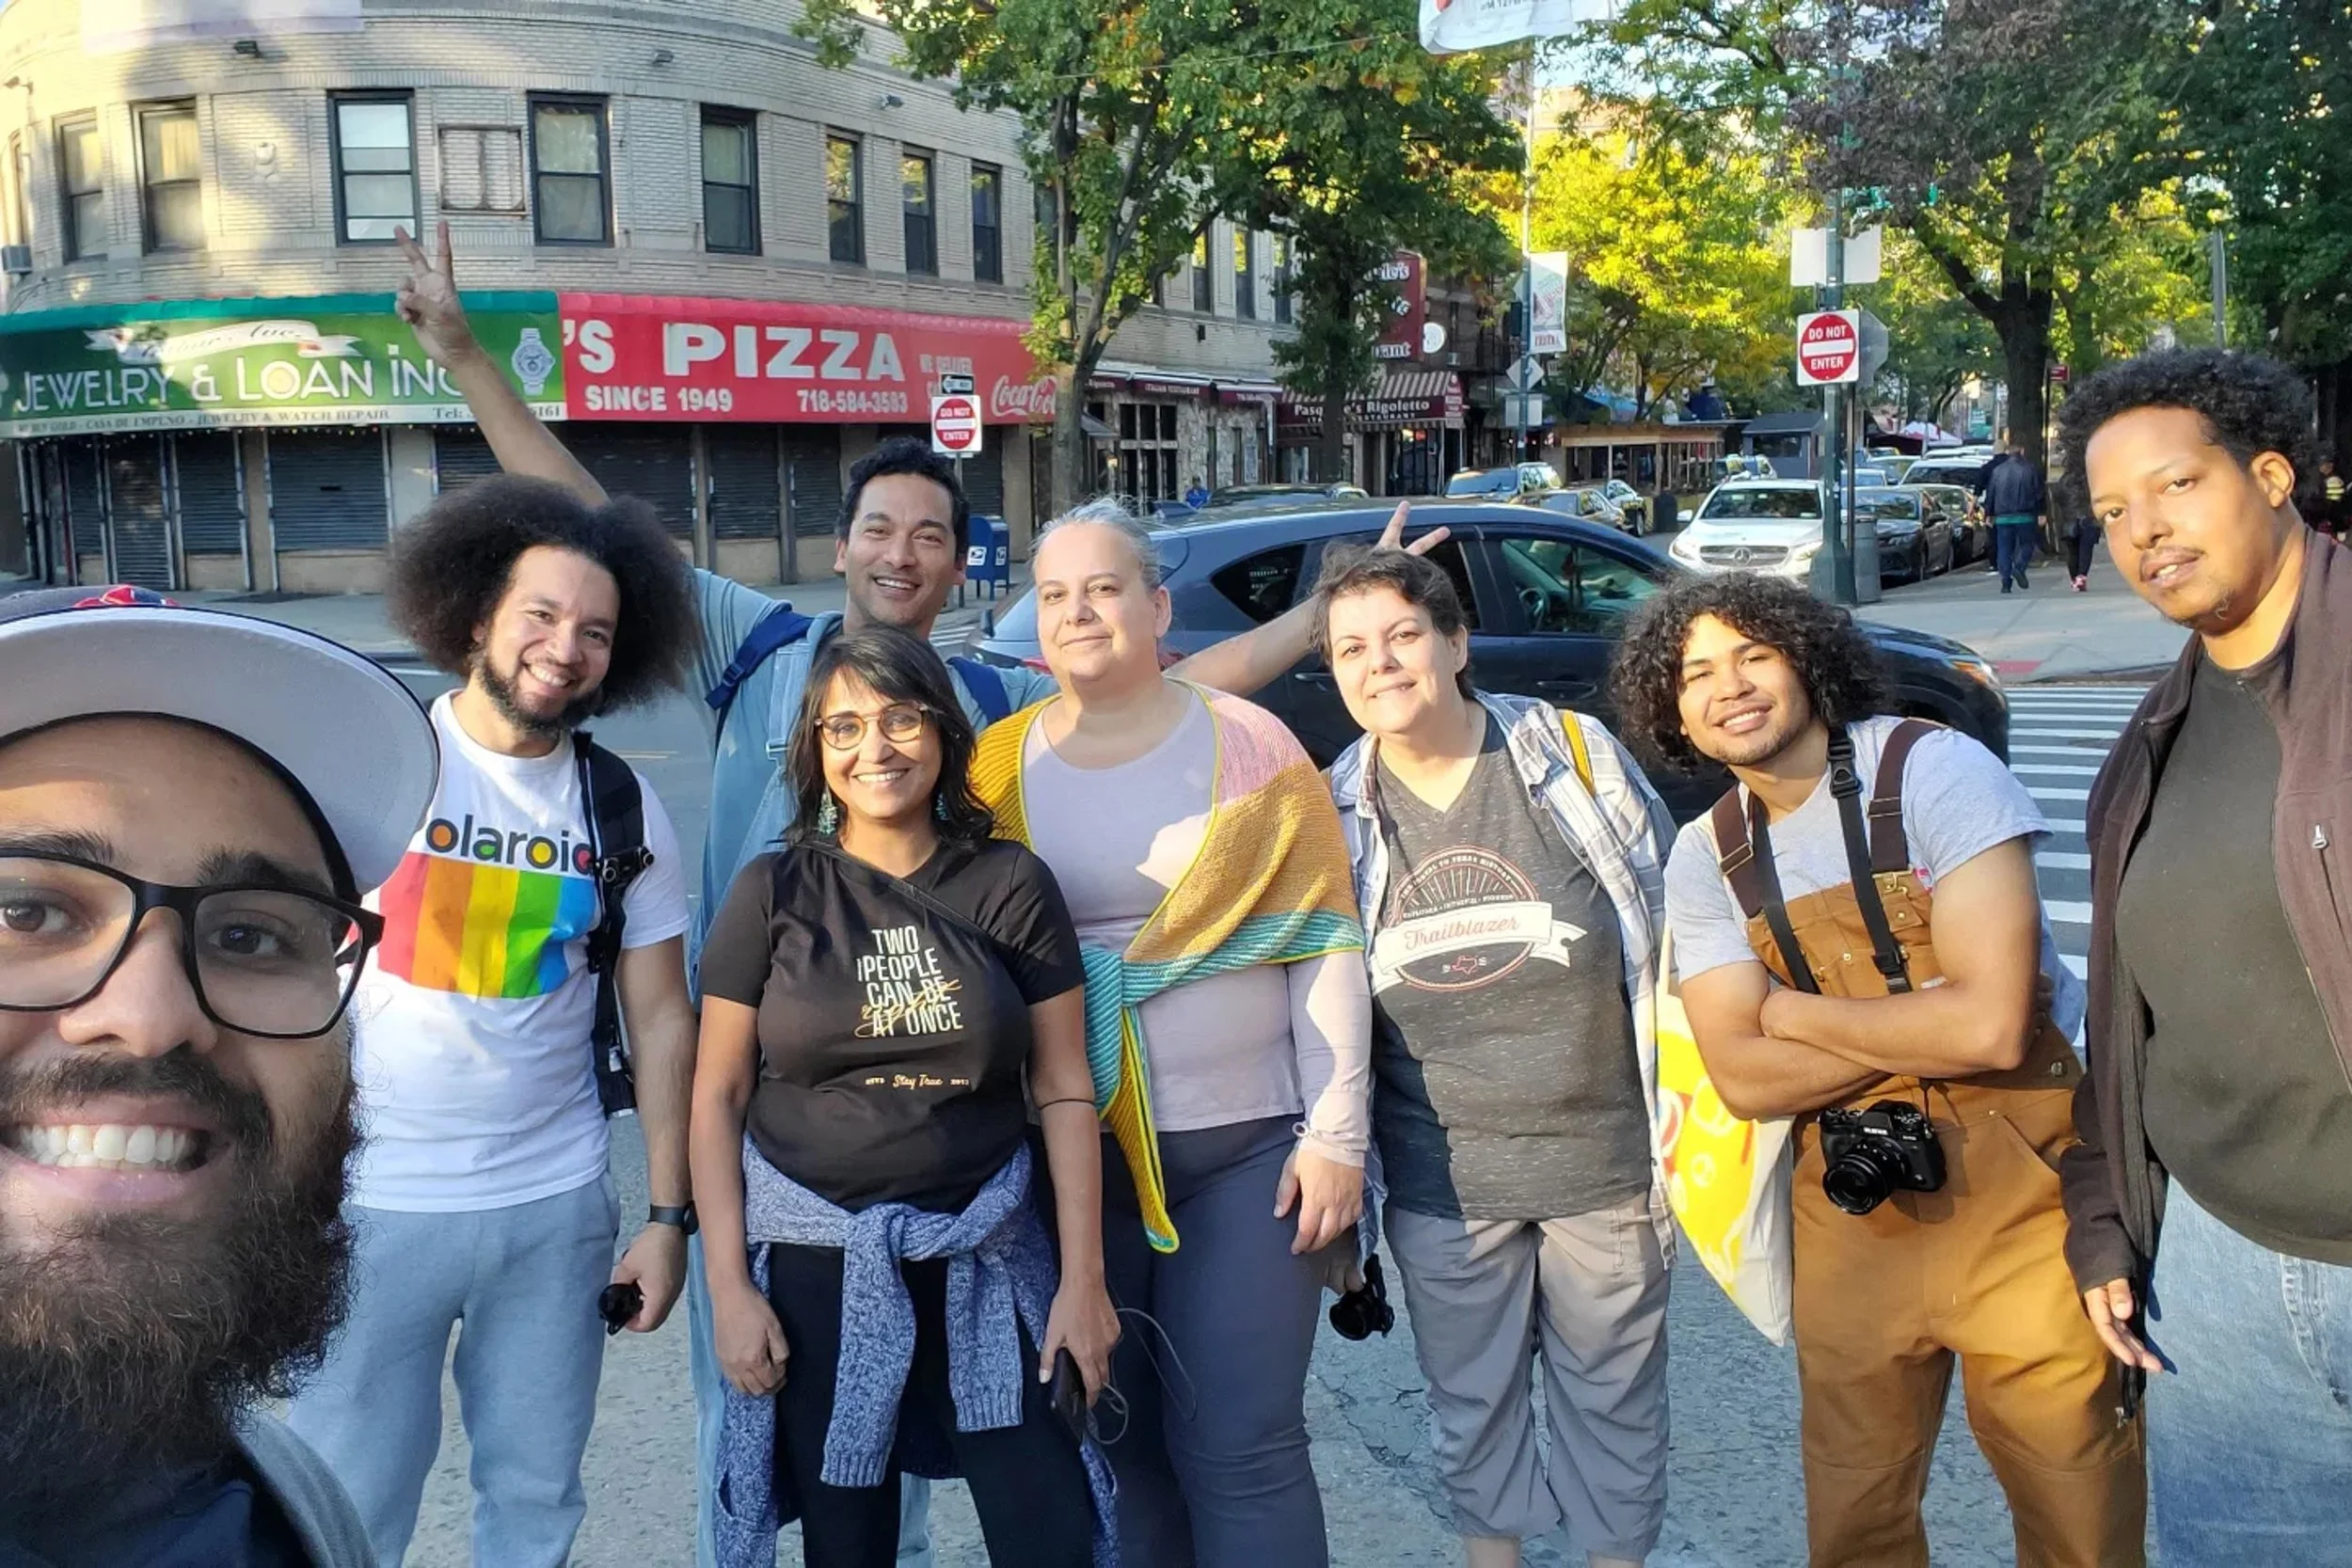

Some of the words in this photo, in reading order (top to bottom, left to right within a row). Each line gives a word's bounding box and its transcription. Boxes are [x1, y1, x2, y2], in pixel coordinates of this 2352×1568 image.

[1808, 328, 1823, 340] DO
[1825, 325, 1847, 339] NOT
[662, 322, 906, 381] PIZZA
[1810, 356, 1844, 371] ENTER
[16, 365, 176, 412] JEWELRY
[190, 364, 222, 402] &
[236, 356, 373, 401] LOAN
[433, 407, 464, 420] Tel:
[584, 385, 667, 413] SINCE
[676, 387, 733, 413] 1949
[1366, 400, 1430, 415] Rigoletto
[277, 411, 329, 422] WATCH
[336, 409, 389, 421] REPAIR
[871, 925, 920, 955] TWO
[1403, 915, 1521, 951] Trailblazer
[866, 980, 914, 1008] CAN
[920, 975, 952, 1004] BE
[905, 1001, 963, 1036] ONCE
